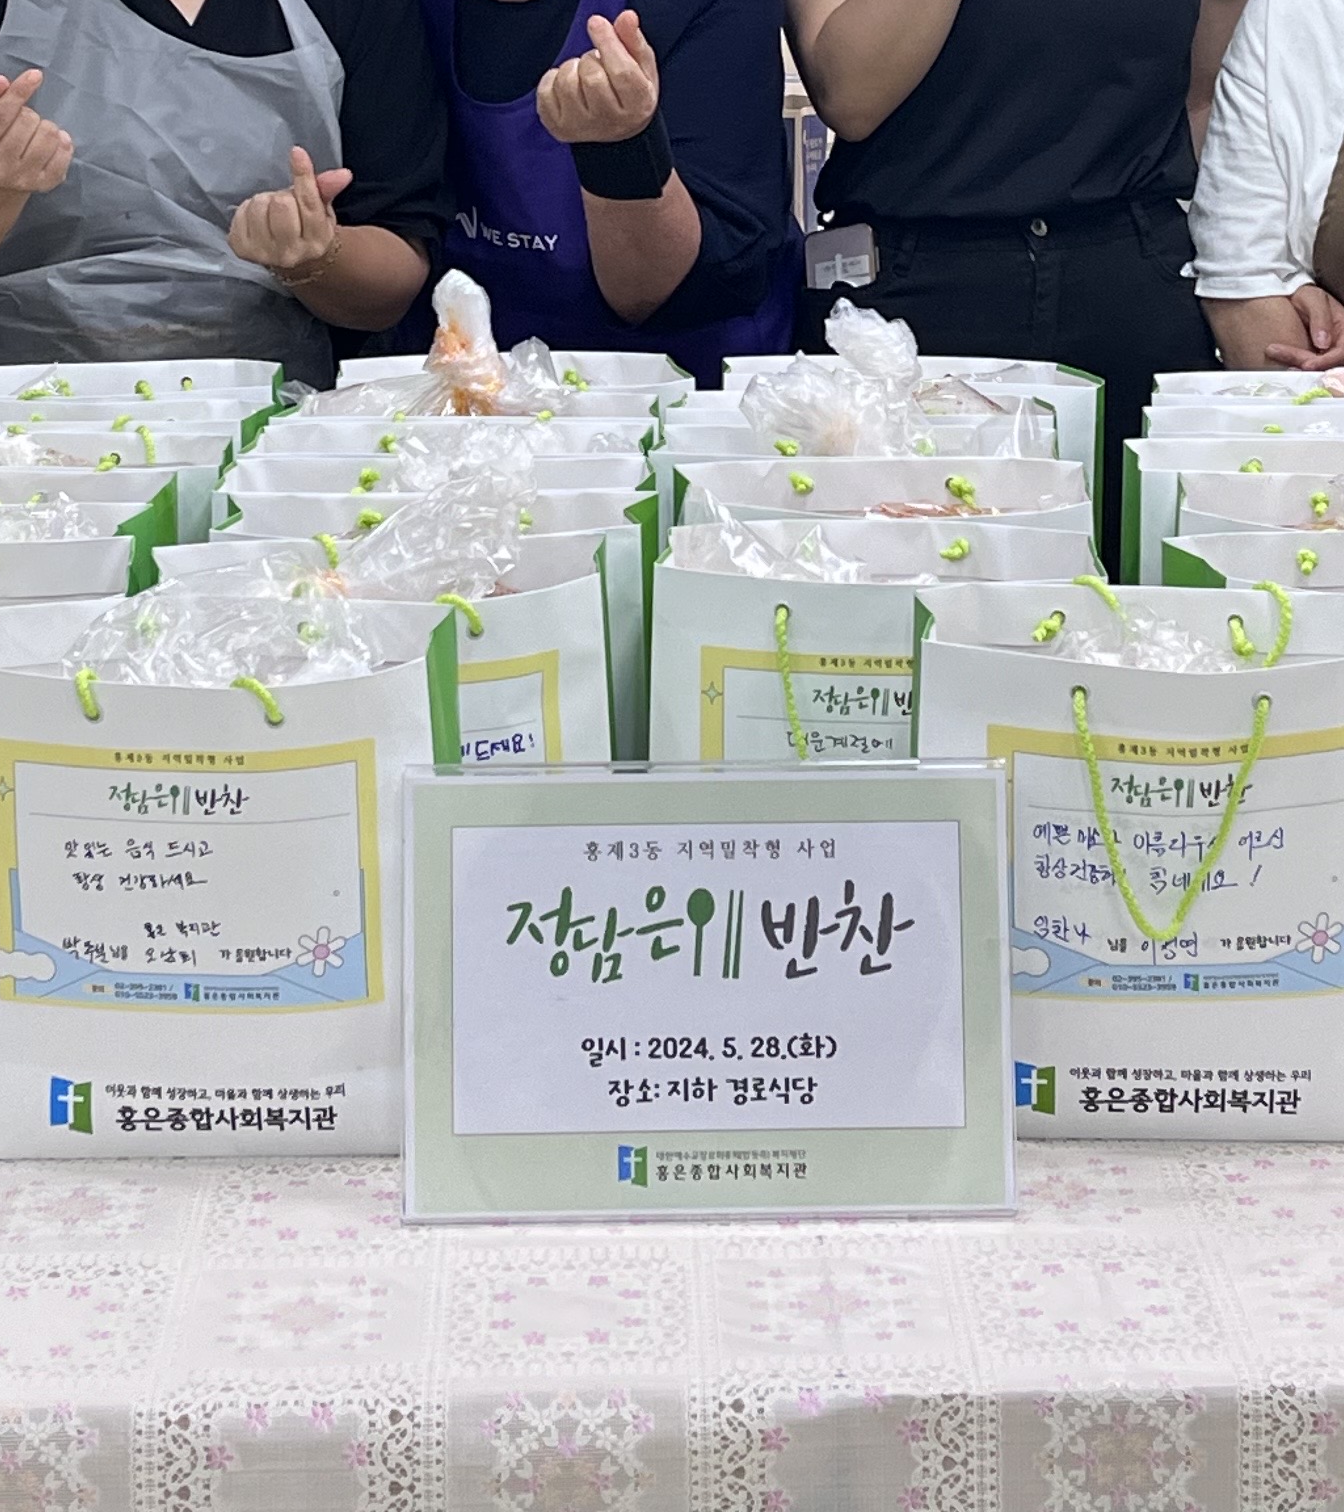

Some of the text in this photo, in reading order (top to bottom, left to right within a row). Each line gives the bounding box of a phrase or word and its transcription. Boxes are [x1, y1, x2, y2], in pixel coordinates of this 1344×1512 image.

[506, 232, 558, 251] STAY
[223, 754, 246, 766] 사업
[194, 783, 251, 816] 반찬
[582, 837, 838, 862] 홍제3동 지역밀착형 사업
[505, 878, 916, 985] 정담은 반찬
[1236, 935, 1291, 950] 응원합니다
[235, 948, 292, 963] 응원합니다
[580, 1037, 627, 1068] 일시
[647, 1037, 715, 1061] 2024.
[721, 1037, 744, 1061] 5.
[750, 1032, 838, 1061] 28.(화)
[1069, 1067, 1102, 1080] 이웃과
[1105, 1067, 1127, 1080] 함께
[1180, 1069, 1213, 1081] 마을과
[1217, 1069, 1239, 1081] 함께
[1243, 1069, 1286, 1082] 상생하는
[1290, 1069, 1311, 1081] 우리
[105, 1083, 137, 1099] 이웃과
[140, 1085, 163, 1100] 함께
[214, 1087, 248, 1100] 마을과
[251, 1087, 273, 1100] 함께
[277, 1087, 321, 1101] 상생하는
[324, 1083, 347, 1099] 우리
[666, 1076, 718, 1102] 지하
[725, 1076, 818, 1106] 경로식당
[1078, 1086, 1301, 1115] 홍은종합사회복지관
[115, 1105, 338, 1132] 홍은종합사회복지관
[655, 1162, 807, 1182] 홍은종합사회복지관
